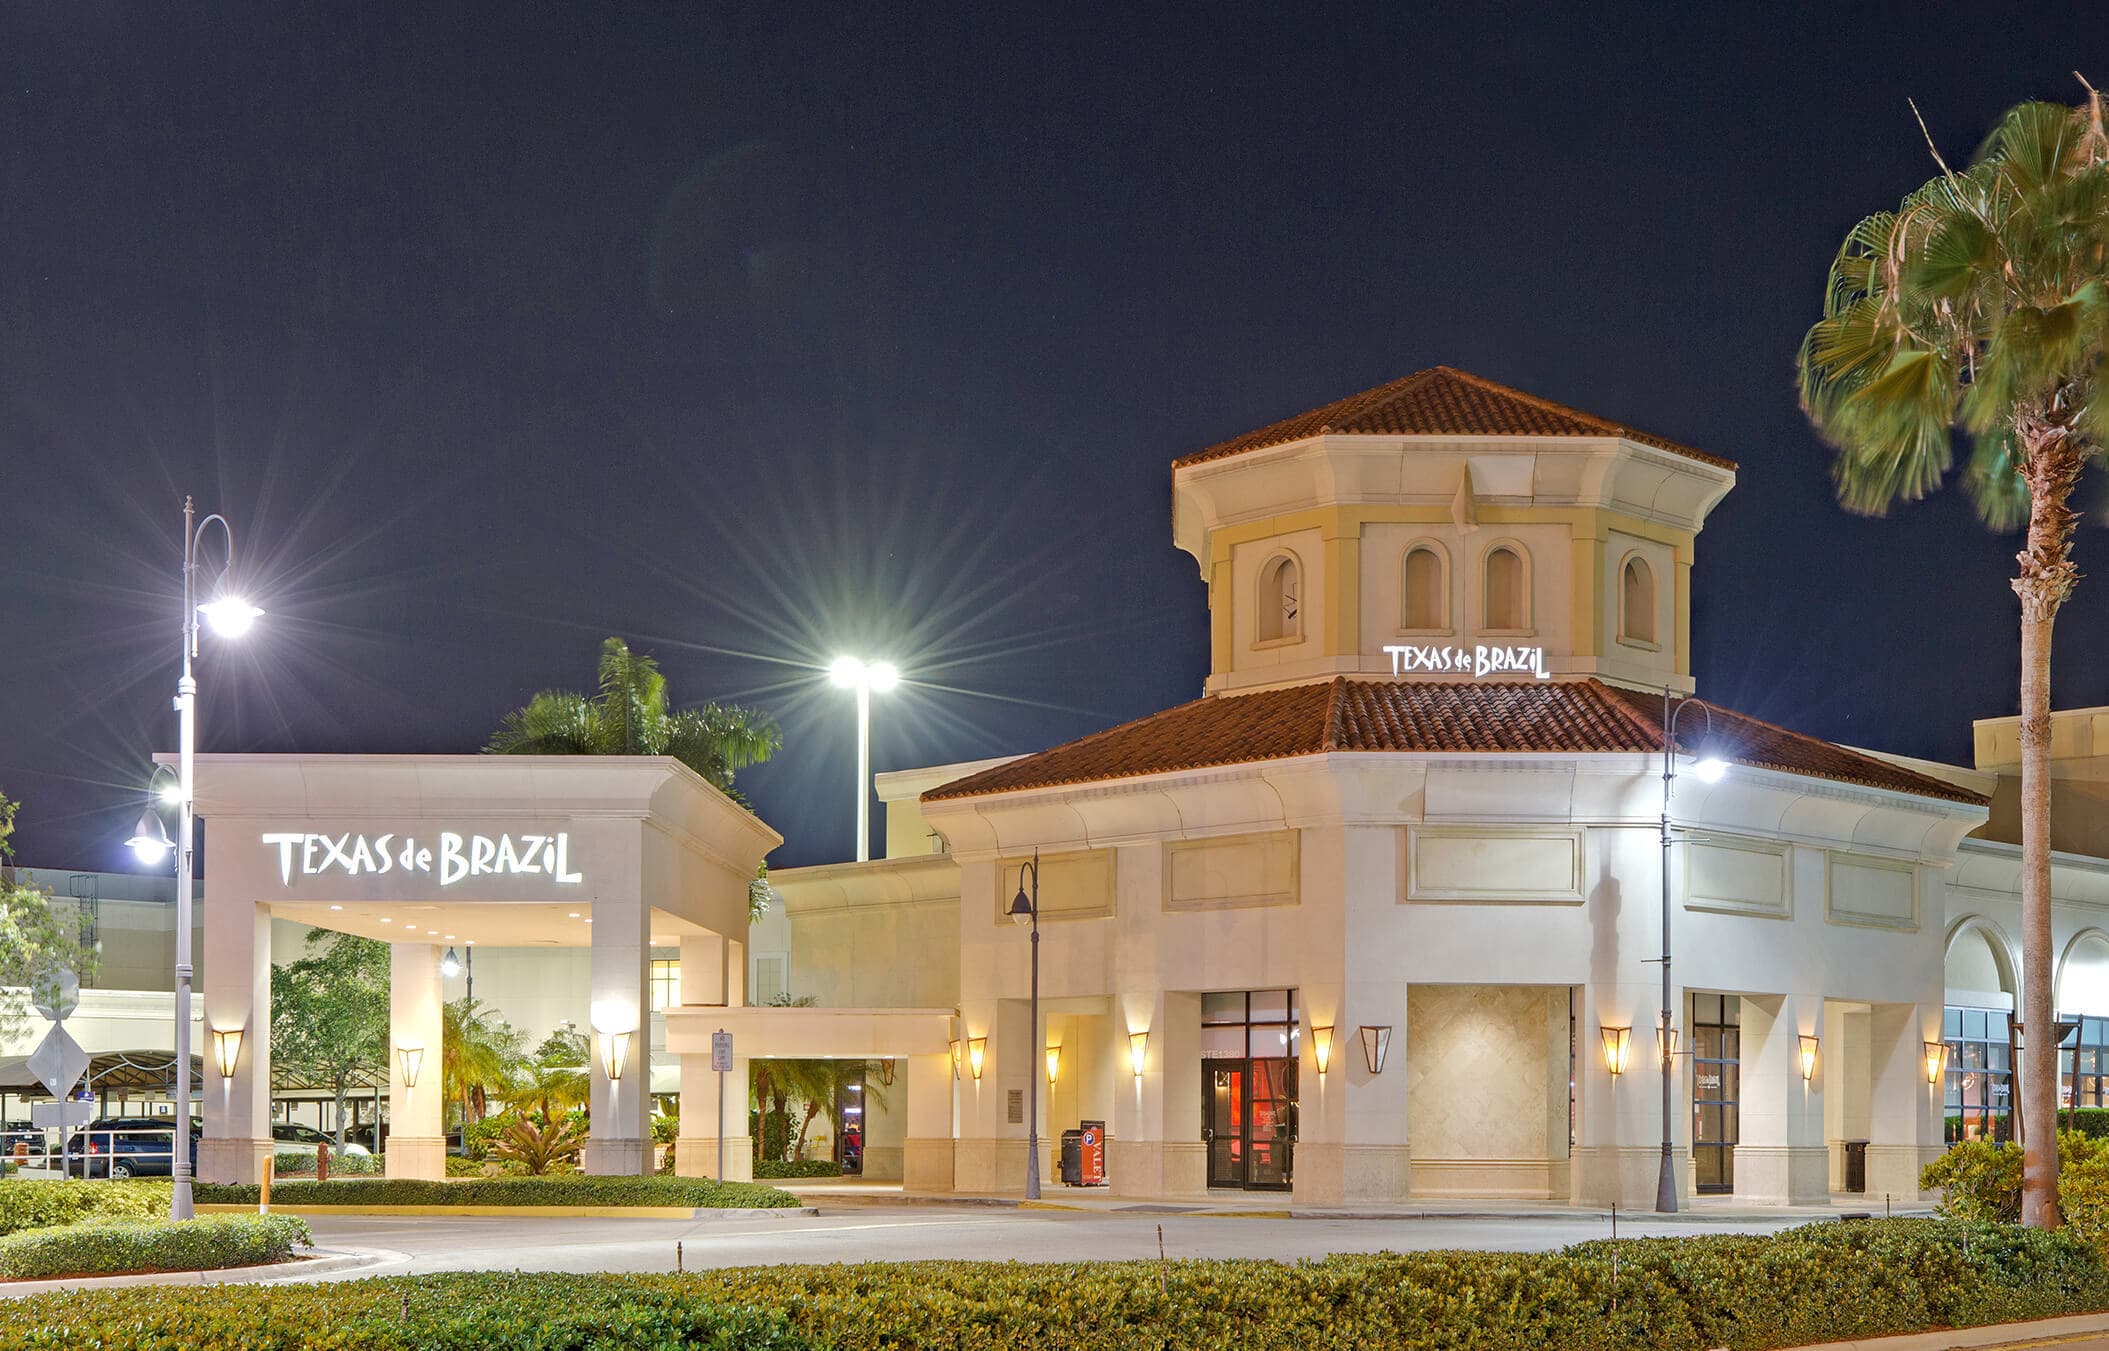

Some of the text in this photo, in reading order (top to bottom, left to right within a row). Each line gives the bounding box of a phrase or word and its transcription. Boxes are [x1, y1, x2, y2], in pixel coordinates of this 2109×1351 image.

[1383, 645, 1452, 678] TEXAS
[1454, 649, 1471, 672] de
[262, 832, 395, 888] TEXAS
[400, 838, 432, 872] de
[1093, 1142, 1102, 1181] VALET
